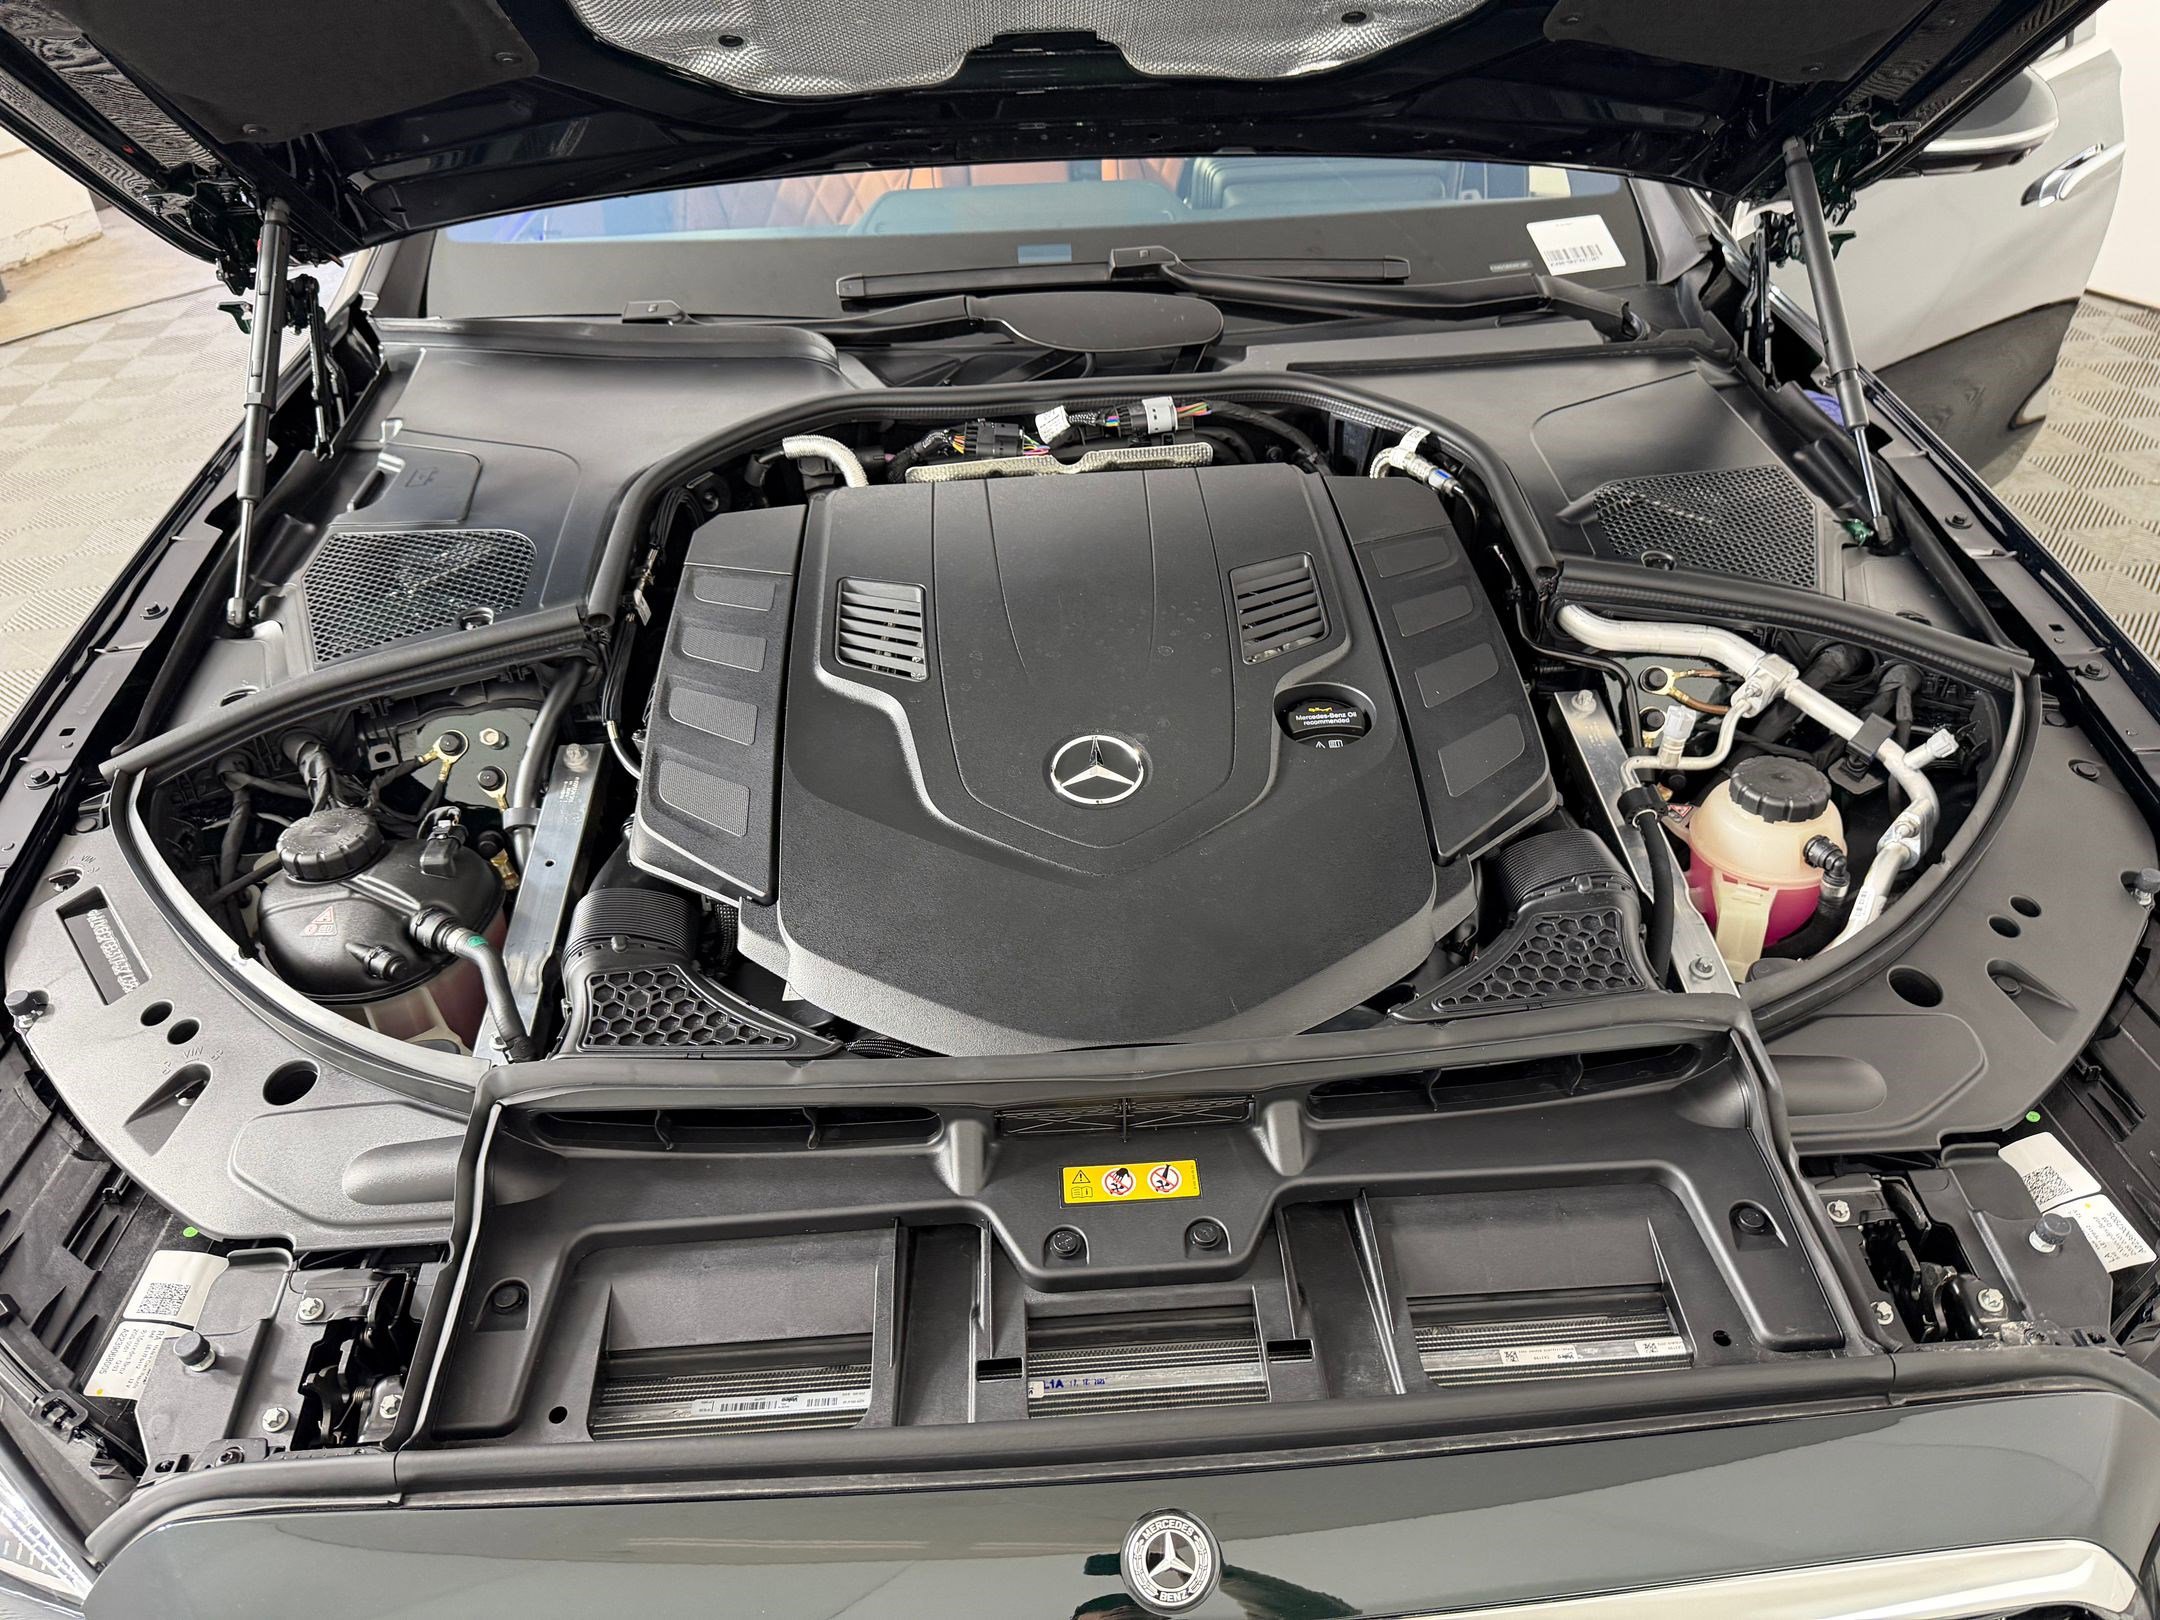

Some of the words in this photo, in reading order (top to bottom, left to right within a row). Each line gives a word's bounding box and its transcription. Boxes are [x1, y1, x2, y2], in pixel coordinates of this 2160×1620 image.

[1295, 711, 1346, 721] Mercedes-Benz
[1303, 718, 1351, 726] recommended
[781, 1395, 799, 1403] Valeo
[1142, 1520, 1194, 1540] MERCEDES
[1159, 1590, 1189, 1602] BENZ
